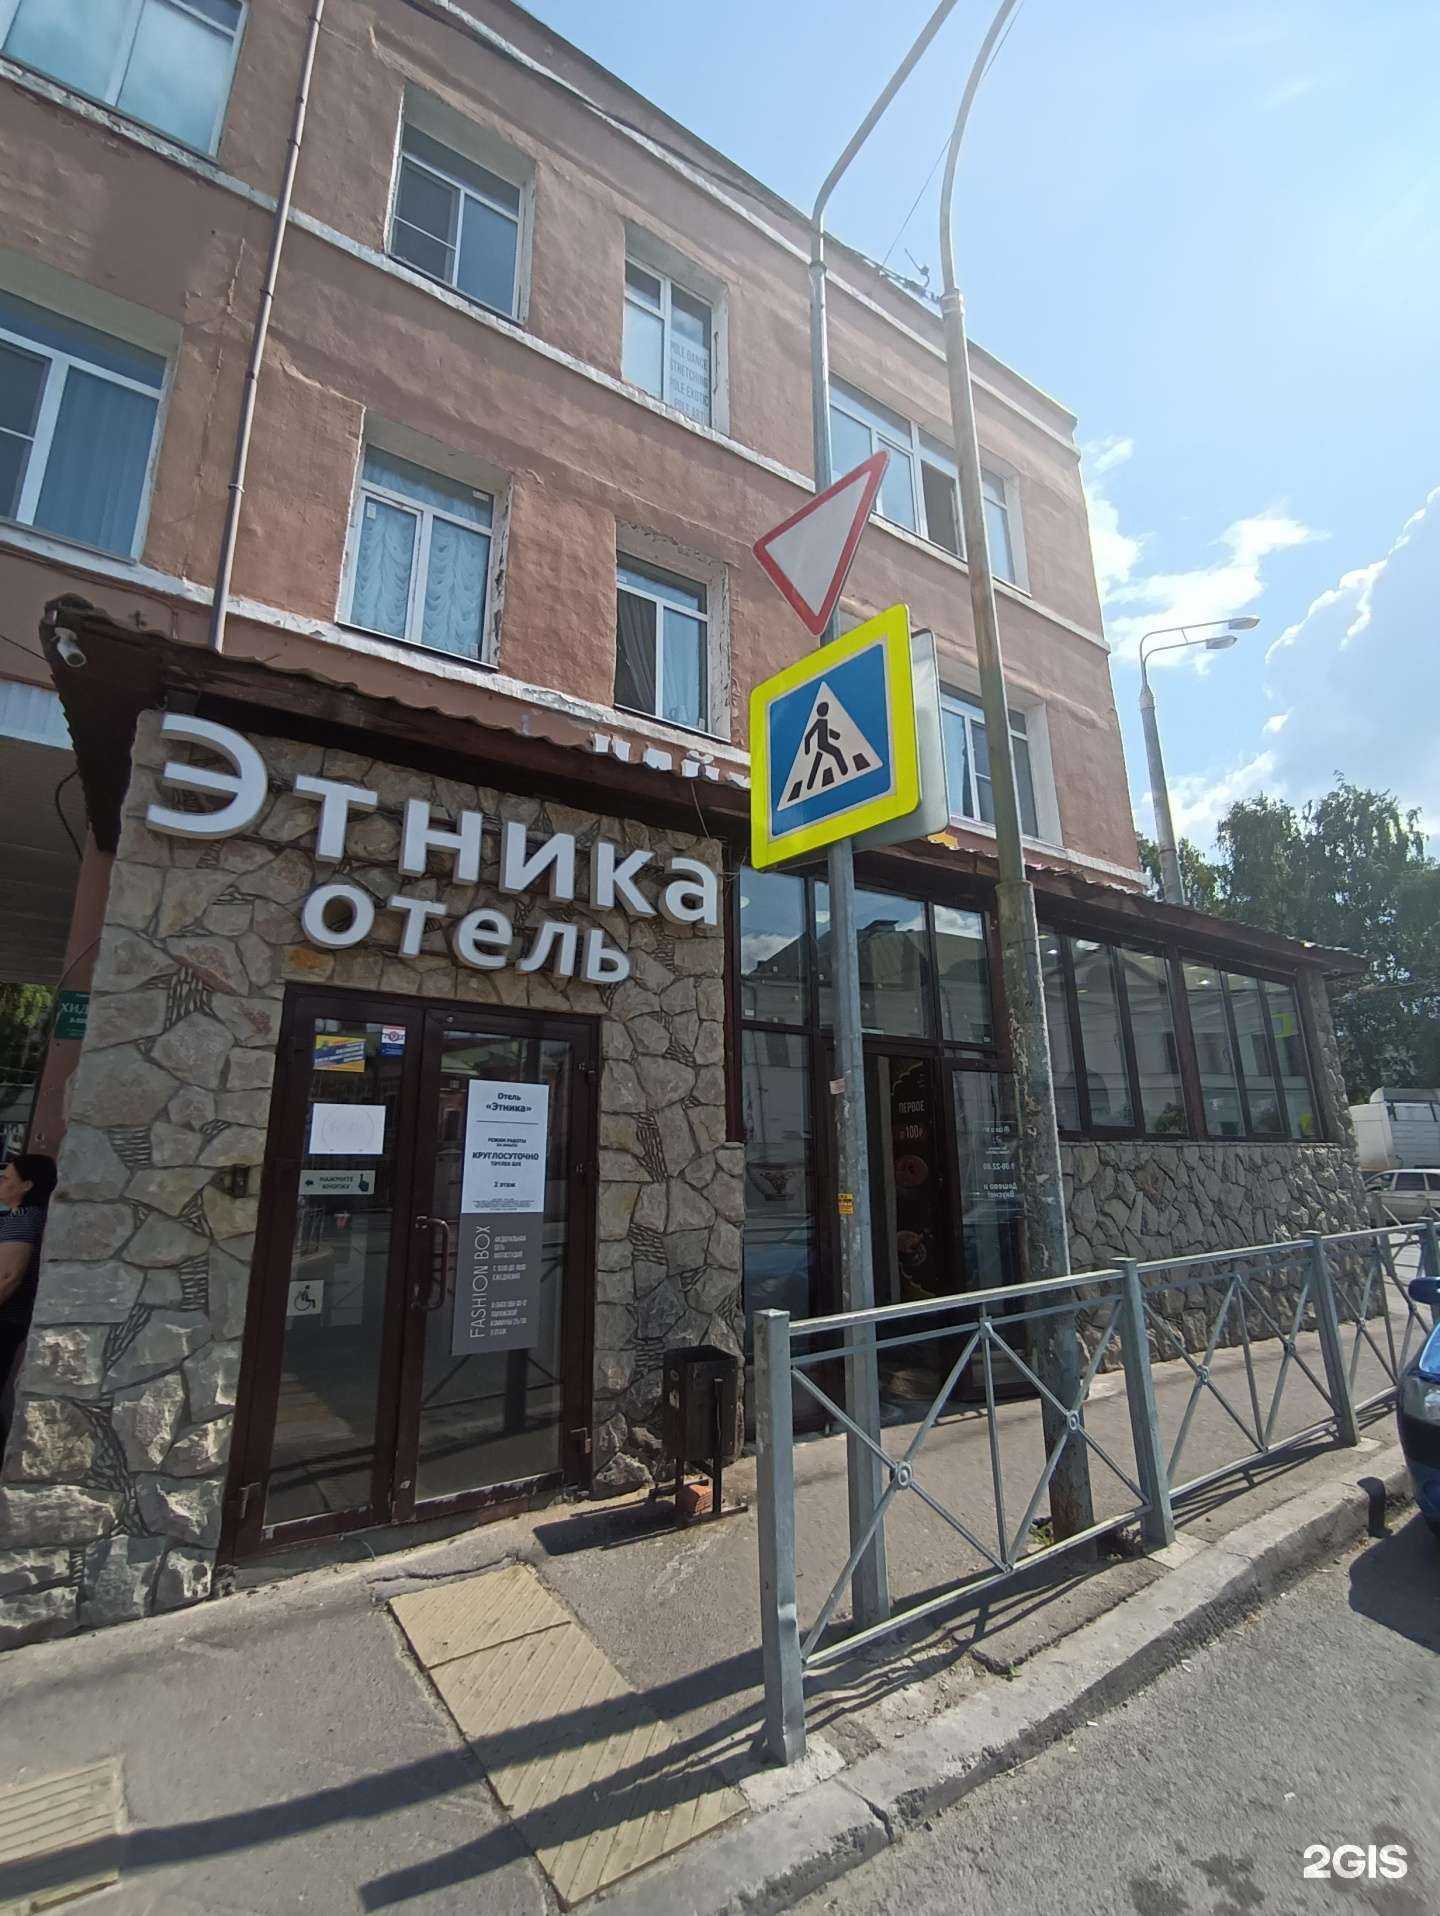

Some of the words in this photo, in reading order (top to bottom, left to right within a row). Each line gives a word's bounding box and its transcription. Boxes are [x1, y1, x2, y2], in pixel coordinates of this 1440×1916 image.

[145, 712, 719, 926] Этника
[301, 882, 632, 985] отель
[485, 1102, 533, 1113] «Этника»
[497, 1092, 522, 1101] Отель
[898, 1099, 925, 1113] ПЕРВОЕ
[472, 1151, 540, 1161] КРУГЛОСУТОЧНО
[474, 1226, 491, 1260] BOX
[470, 1265, 489, 1338] FASHION
